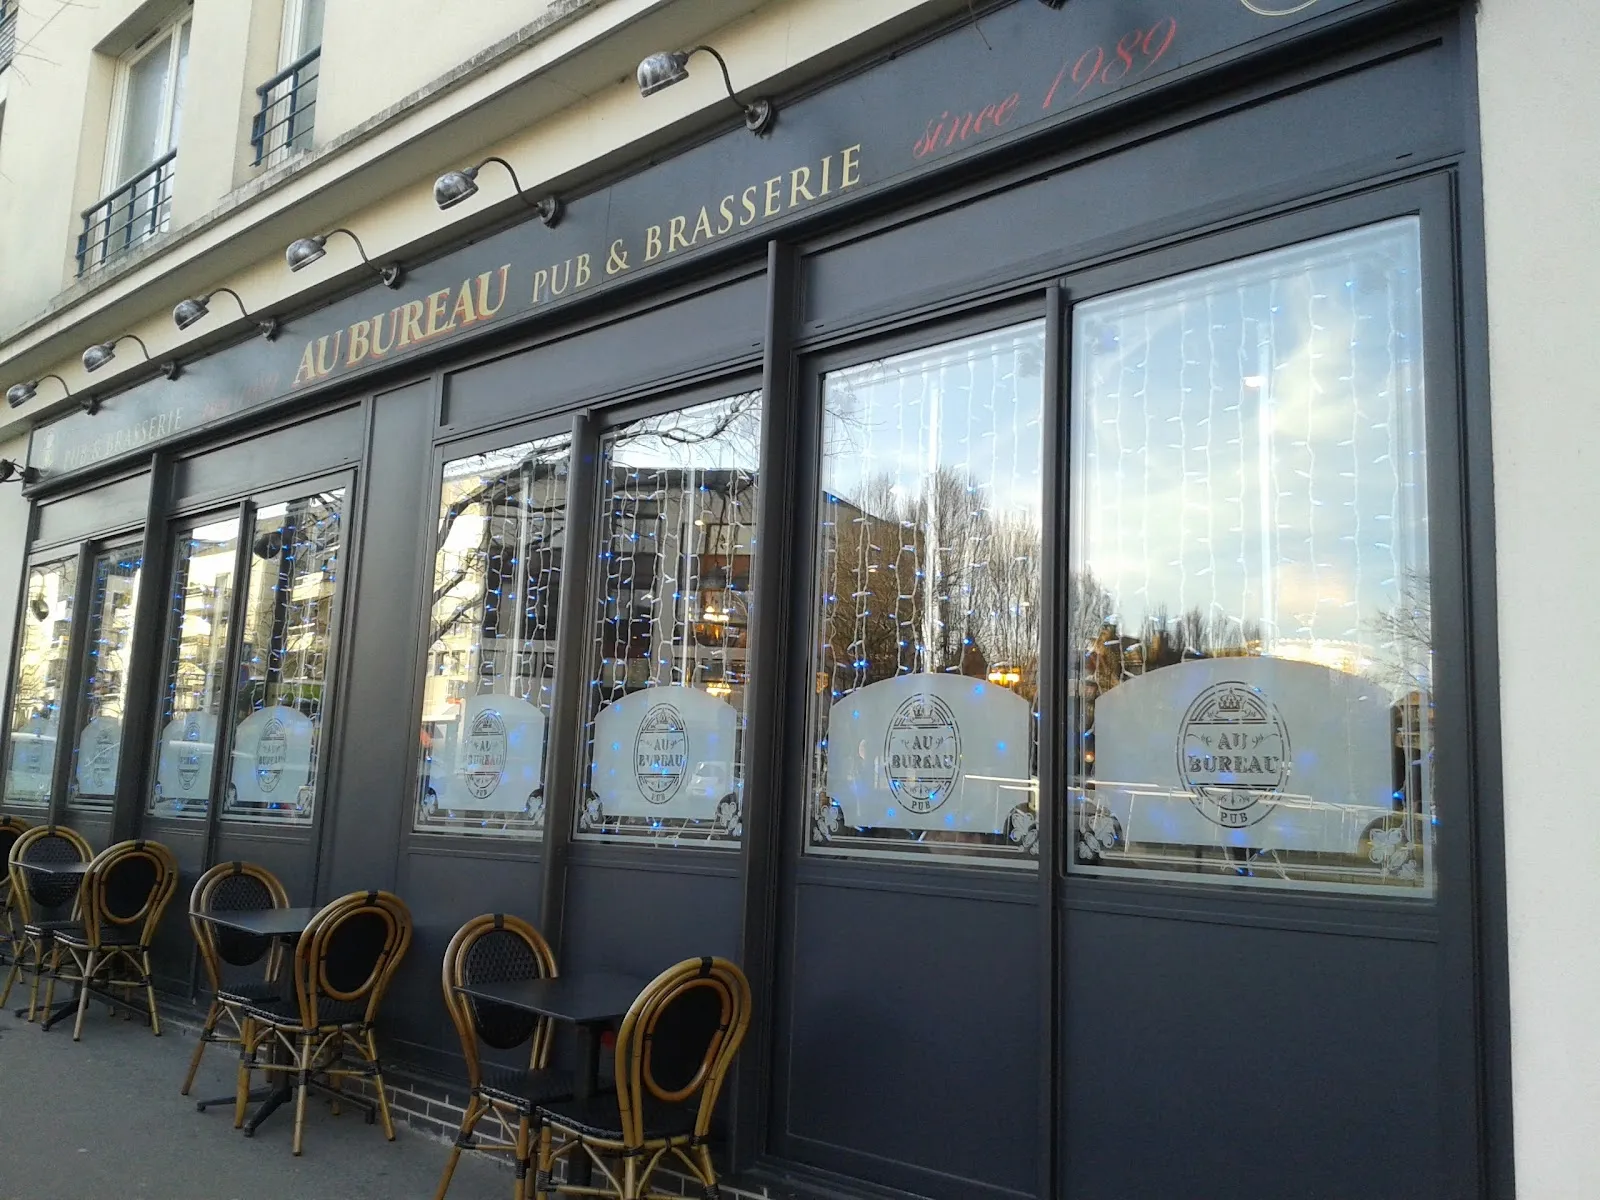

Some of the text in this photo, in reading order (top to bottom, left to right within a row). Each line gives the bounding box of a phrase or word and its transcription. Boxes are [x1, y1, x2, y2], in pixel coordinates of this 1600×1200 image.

[293, 17, 1178, 387] AU BUREAU PUB & BRASSERIE since 1989
[653, 739, 668, 751] AU
[912, 735, 933, 750] AU
[1218, 732, 1248, 750] AU
[638, 754, 683, 767] BUREAU
[891, 754, 954, 769] BUREAU
[1187, 755, 1280, 774] BUREAU
[911, 800, 931, 811] PUB
[1220, 811, 1248, 824] PUB
